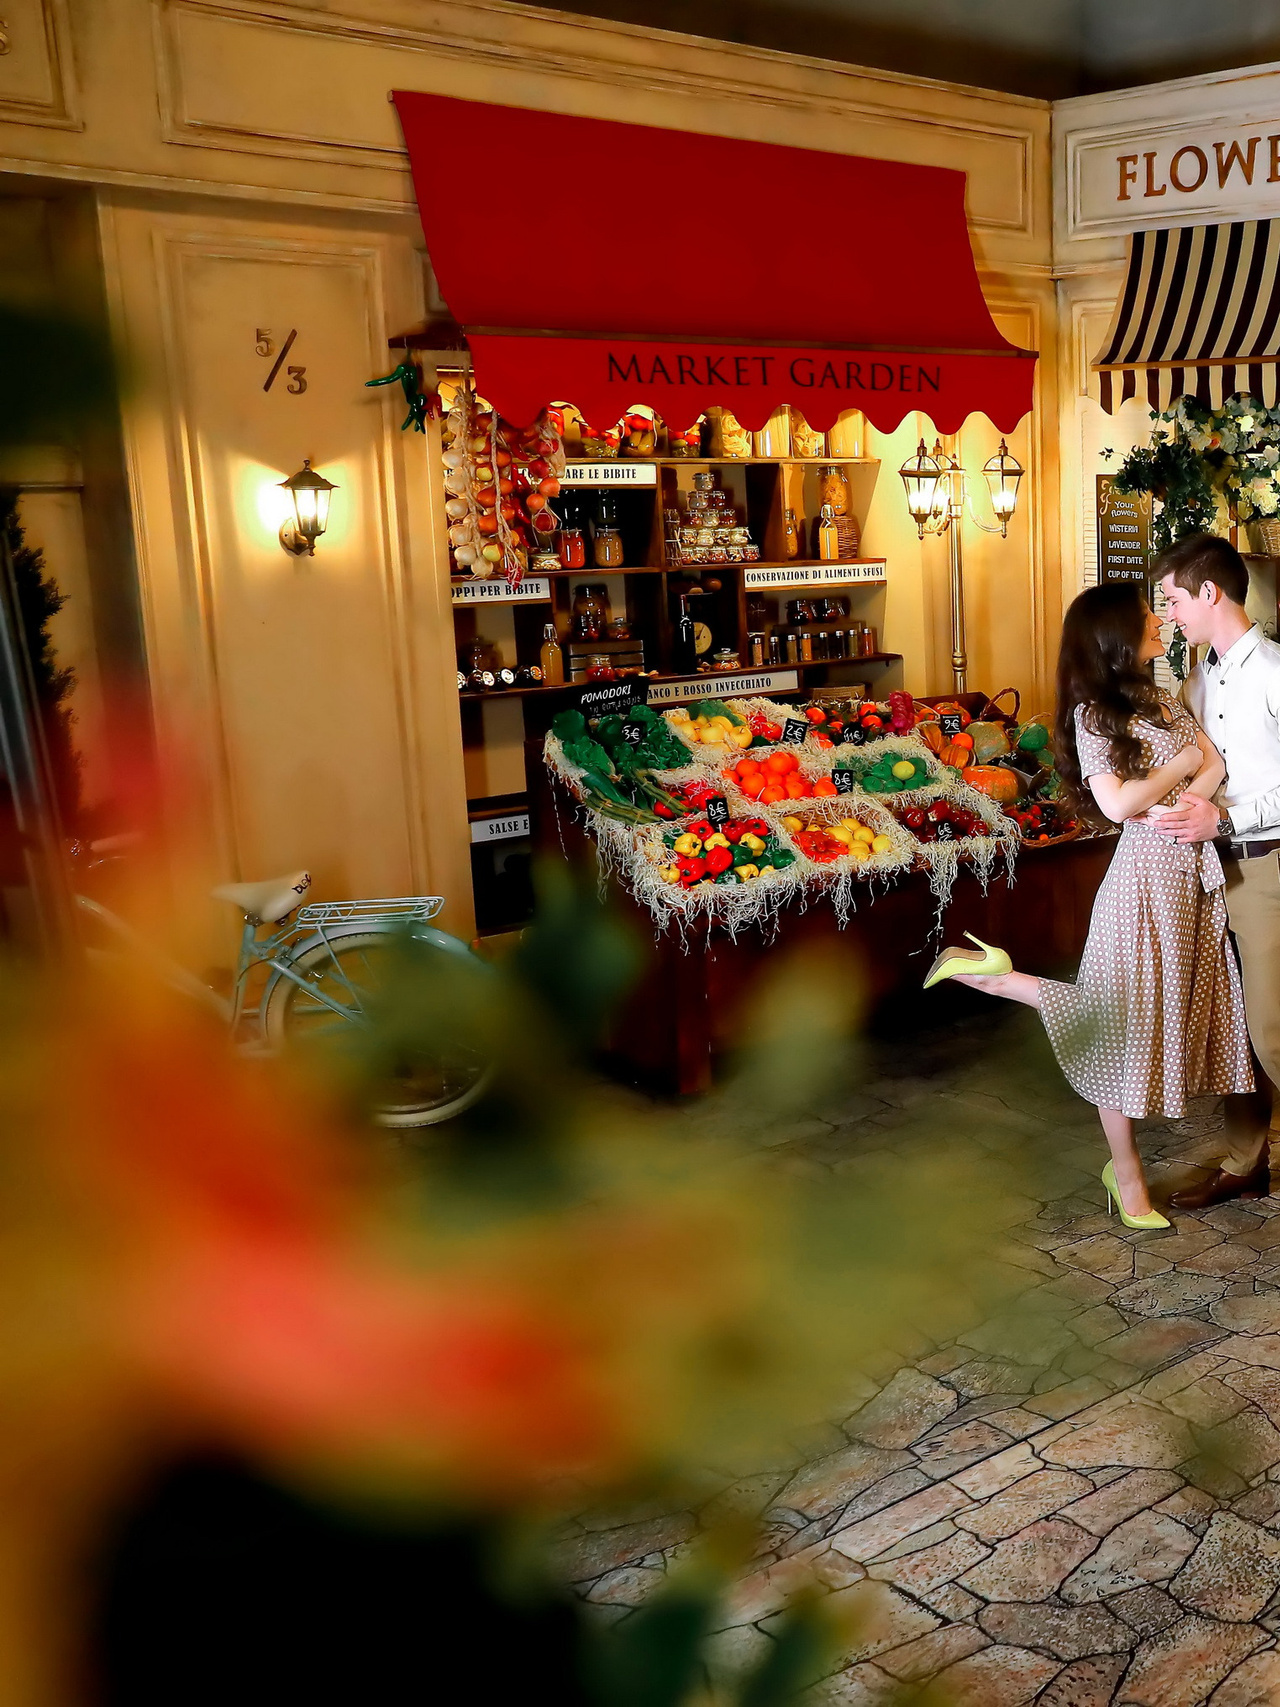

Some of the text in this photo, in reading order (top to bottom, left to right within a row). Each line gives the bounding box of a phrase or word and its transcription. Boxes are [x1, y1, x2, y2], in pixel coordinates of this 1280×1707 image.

[608, 352, 941, 393] MARKET GARDEN
[589, 469, 599, 479] LE
[603, 468, 637, 479] BIBITE
[1114, 501, 1135, 509] Your
[1111, 509, 1138, 519] flowers
[1109, 524, 1138, 533] WISTERIA
[1108, 540, 1141, 550] LAVENDER
[1107, 555, 1143, 565] FIRST DATE
[746, 566, 883, 583] CONSERVAZIONE DI ALIMENTI SFUSI
[1107, 570, 1144, 580] CUP OF TEA
[480, 585, 500, 596] PER
[674, 686, 680, 697] E
[683, 683, 712, 696] ROSSO
[715, 677, 772, 693] INVECCHIATO
[581, 684, 632, 704] POMODORI
[944, 718, 960, 731] 9€
[786, 724, 804, 741] 2€
[834, 772, 852, 786] 8€
[708, 801, 727, 817] 8€
[489, 820, 519, 834] SALSE
